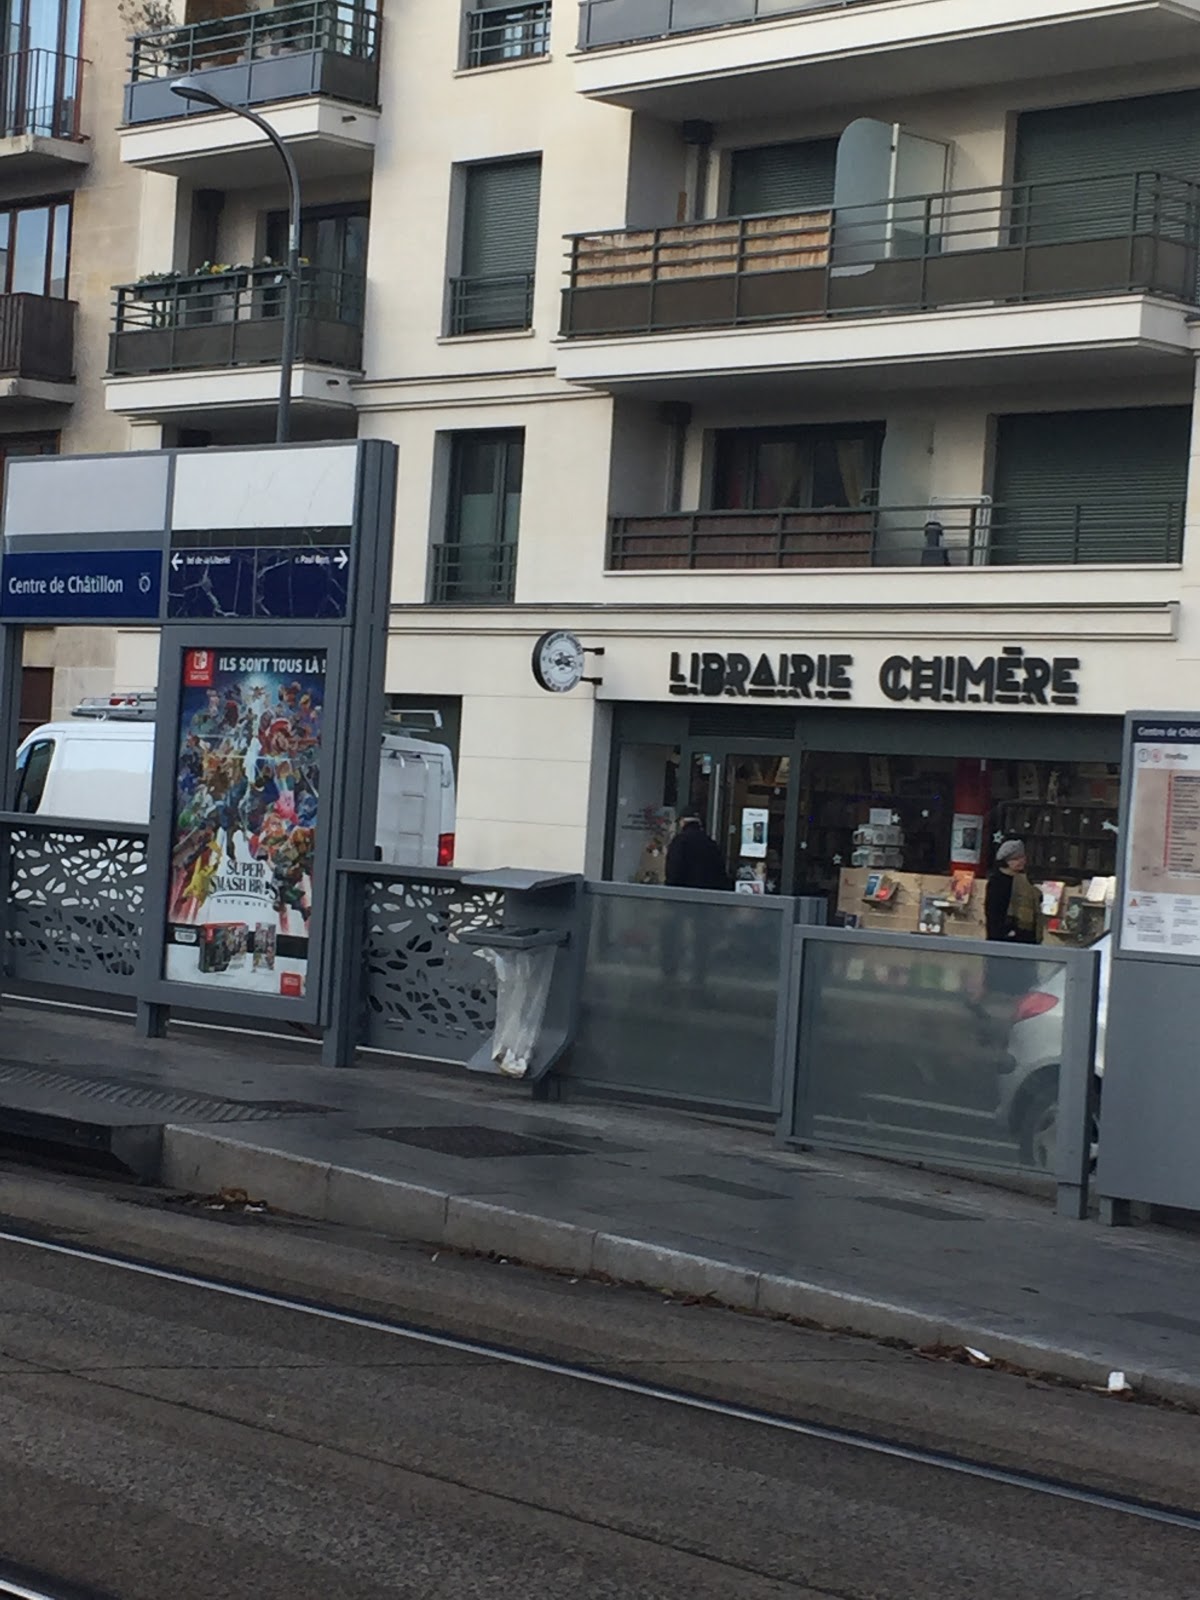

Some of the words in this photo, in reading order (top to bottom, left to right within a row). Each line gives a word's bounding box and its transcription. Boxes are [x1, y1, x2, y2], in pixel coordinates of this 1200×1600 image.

[9, 577, 47, 594] Centre
[49, 576, 65, 594] de
[67, 575, 124, 594] Châtillon
[219, 657, 237, 671] ILS
[239, 657, 271, 673] SONT
[272, 658, 303, 674] TOUS
[669, 651, 853, 700] LIBRAIRIE
[1137, 726, 1166, 737] Centre
[1166, 727, 1178, 737] de
[226, 860, 266, 878] SUPER
[207, 876, 247, 895] SMASH
